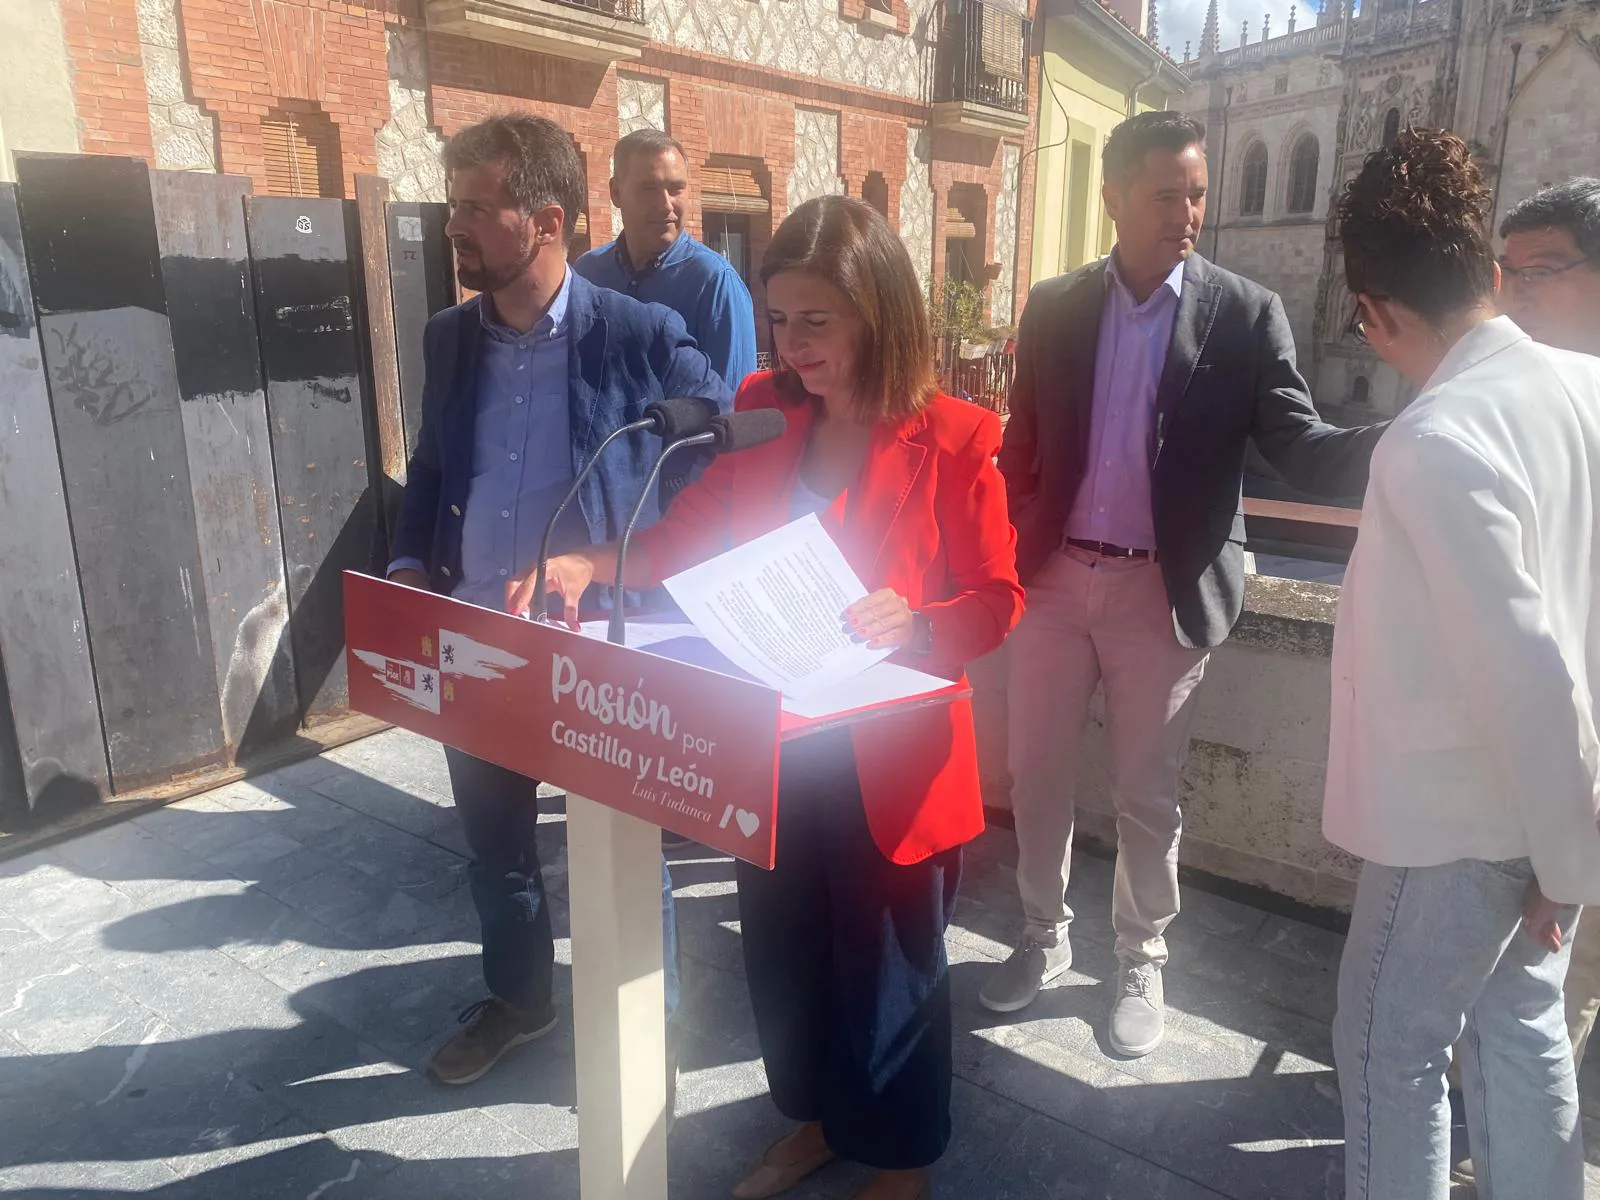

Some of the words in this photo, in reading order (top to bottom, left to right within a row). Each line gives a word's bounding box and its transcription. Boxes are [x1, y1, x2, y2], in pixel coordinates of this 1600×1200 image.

[552, 652, 677, 740] Pasión
[682, 733, 716, 756] por
[551, 720, 631, 769] Castilla
[636, 753, 652, 780] y
[656, 756, 714, 798] León
[631, 781, 656, 802] Luis
[659, 789, 712, 823] Tudanca
